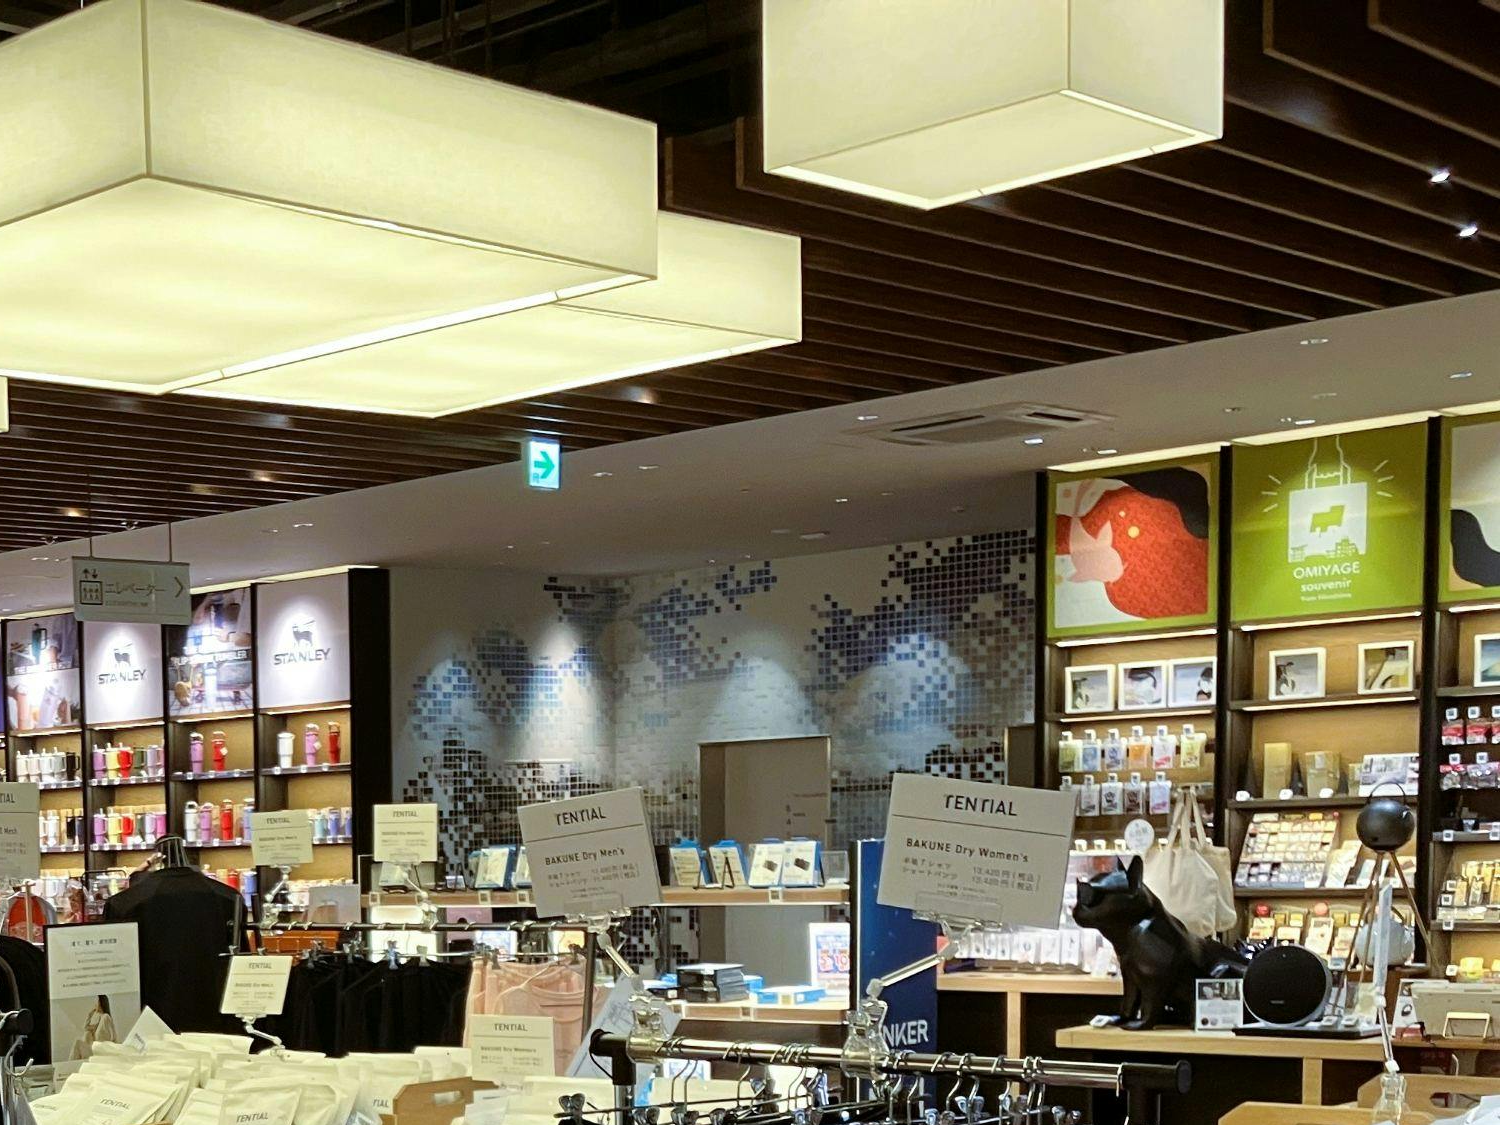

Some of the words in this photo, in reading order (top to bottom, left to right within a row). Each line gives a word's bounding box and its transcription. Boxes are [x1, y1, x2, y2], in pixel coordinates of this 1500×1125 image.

[1293, 561, 1361, 580] OMIYAGE
[1300, 578, 1352, 592] souvenir
[273, 648, 331, 666] STANLEY
[98, 669, 147, 685] STANLEY
[944, 794, 1018, 817] TENTIAL
[555, 807, 607, 826] TENTIAL
[545, 852, 580, 866] BAKUNE
[582, 851, 597, 862] Dry
[906, 838, 951, 852] BAKUNE
[955, 844, 975, 857] Dry
[978, 847, 1028, 862] Women's
[493, 1023, 528, 1032] TENTIAL
[882, 1019, 929, 1048] NKER
[236, 1111, 269, 1123] TENTIAL
